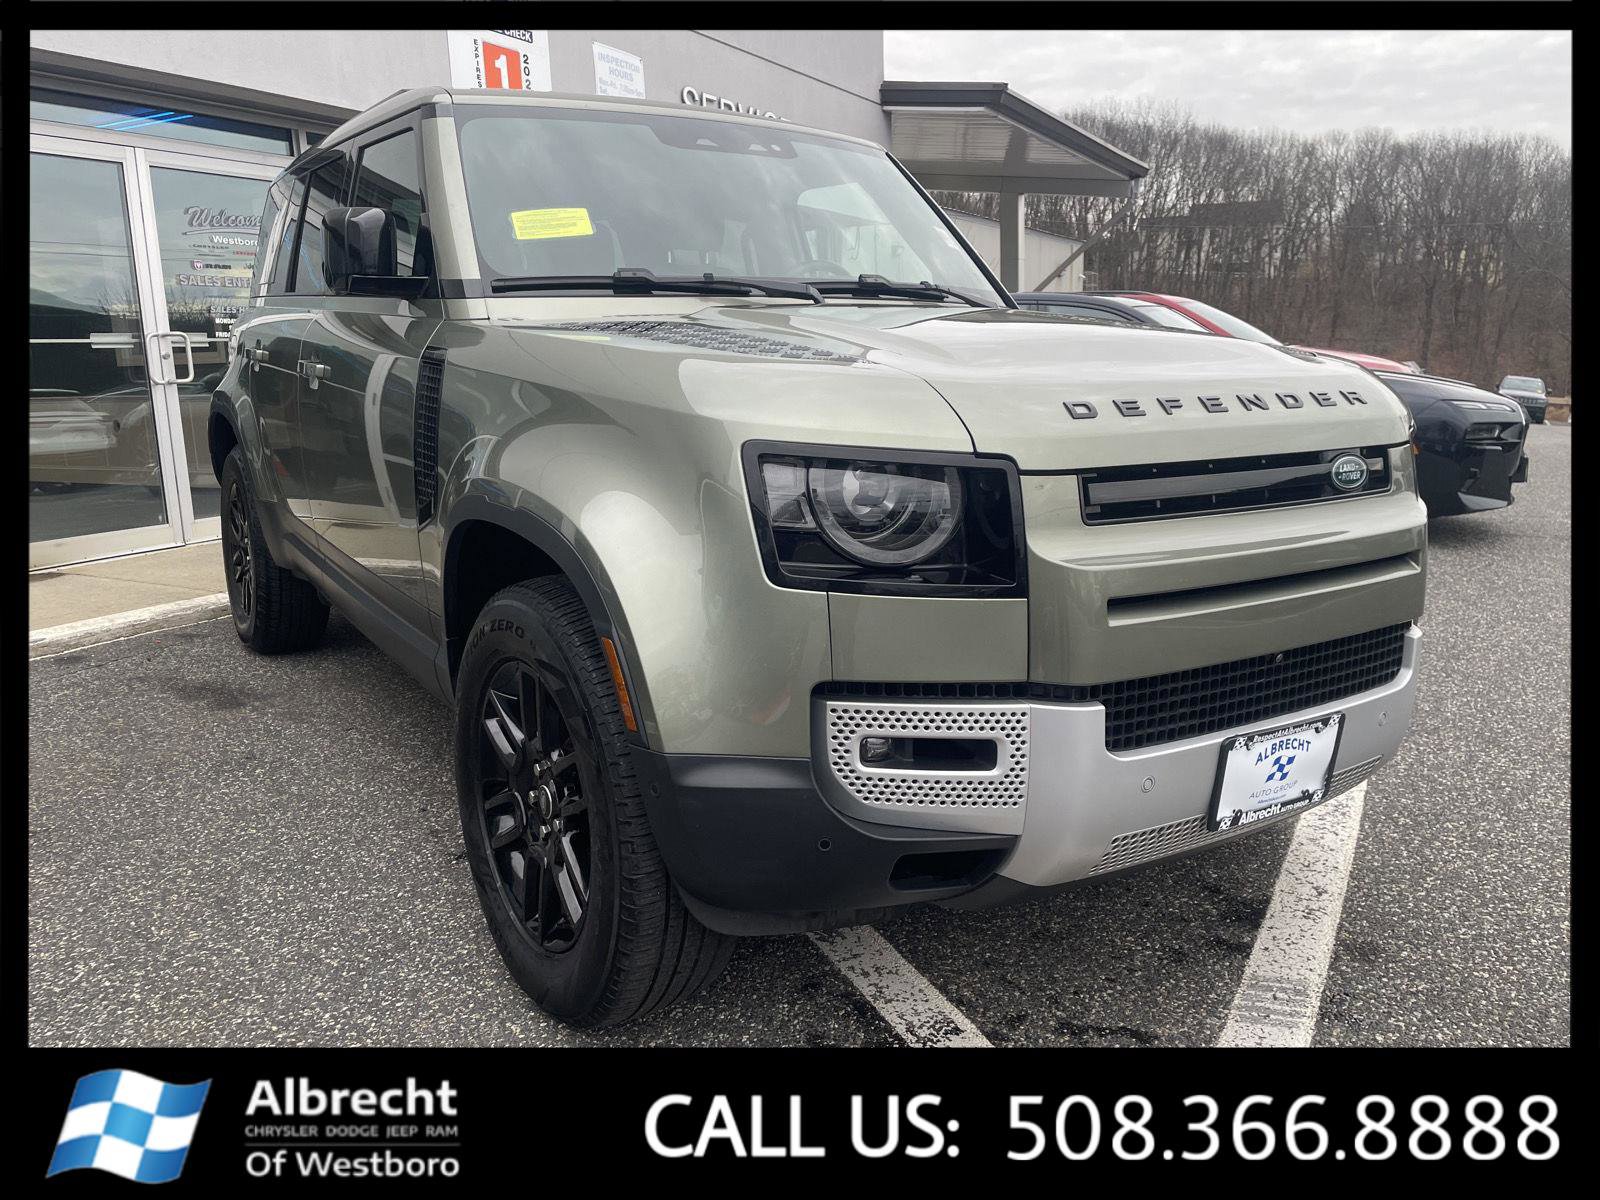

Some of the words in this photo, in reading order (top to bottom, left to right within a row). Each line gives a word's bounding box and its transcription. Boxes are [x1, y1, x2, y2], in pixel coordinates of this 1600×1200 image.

[473, 38, 483, 88] EXPIRES
[495, 54, 509, 90] 1
[598, 52, 640, 74] INSPECTION
[608, 66, 633, 82] HOURS
[179, 274, 221, 287] SALES
[210, 305, 237, 314] SALES
[1062, 389, 1368, 420] DEFENDER
[489, 618, 525, 640] ZERO
[1255, 737, 1311, 766] ALBRECHT
[1249, 788, 1272, 799] AUTO
[1273, 779, 1298, 794] GROUP
[1238, 802, 1281, 825] Albrecht
